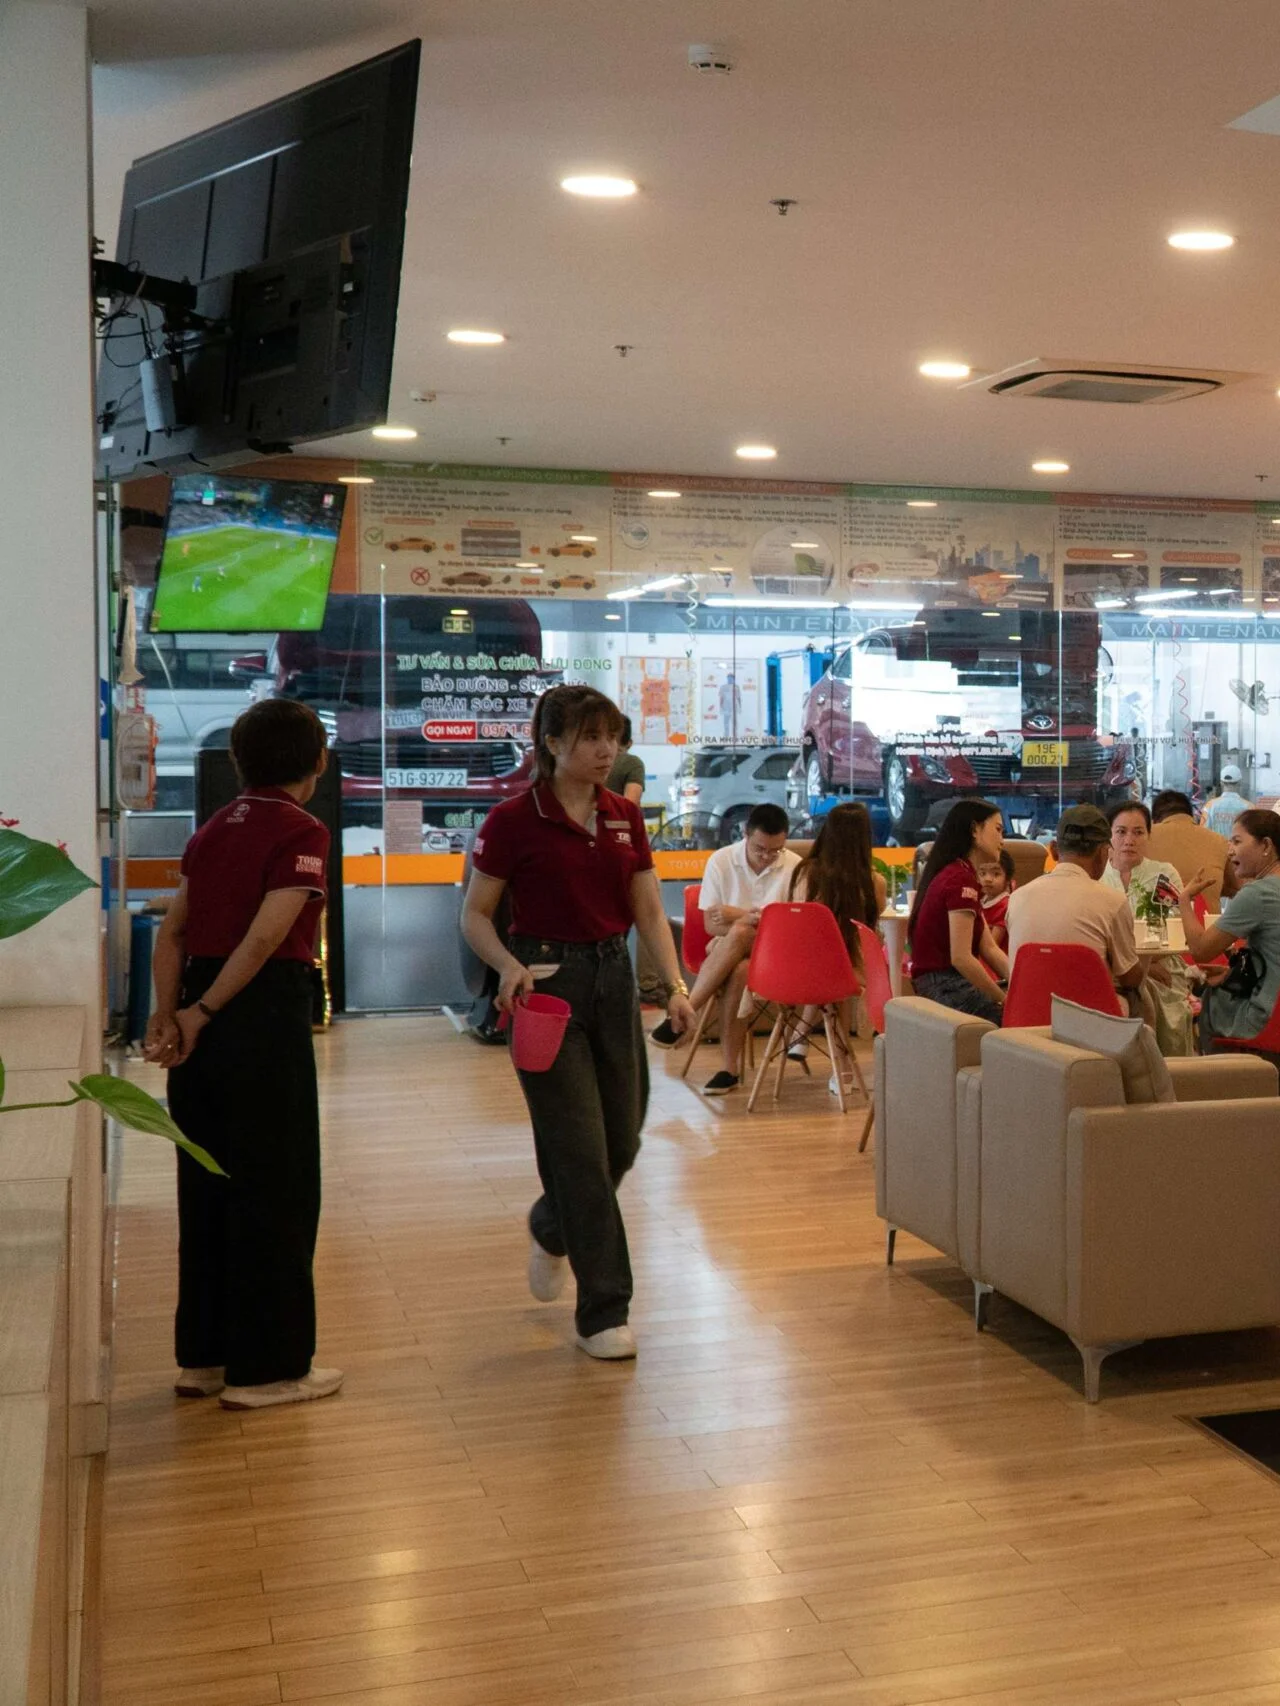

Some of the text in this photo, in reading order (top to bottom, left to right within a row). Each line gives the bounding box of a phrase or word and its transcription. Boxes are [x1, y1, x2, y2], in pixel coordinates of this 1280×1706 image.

[706, 614, 904, 631] MAINTENANC
[420, 651, 450, 671] VẤN
[453, 657, 464, 670] &
[466, 652, 497, 671] SỬA
[499, 652, 539, 671] CHỮA
[421, 674, 454, 692] BẢO
[456, 676, 509, 692] DƯỠNG
[421, 695, 467, 712] CHĂM
[471, 695, 503, 712] SÓC
[507, 698, 528, 712] XE
[426, 726, 446, 737] GỌI
[447, 726, 474, 736] NGAY
[705, 736, 717, 744] RA
[1036, 743, 1056, 754] 19E
[667, 858, 707, 871] TOYOT
